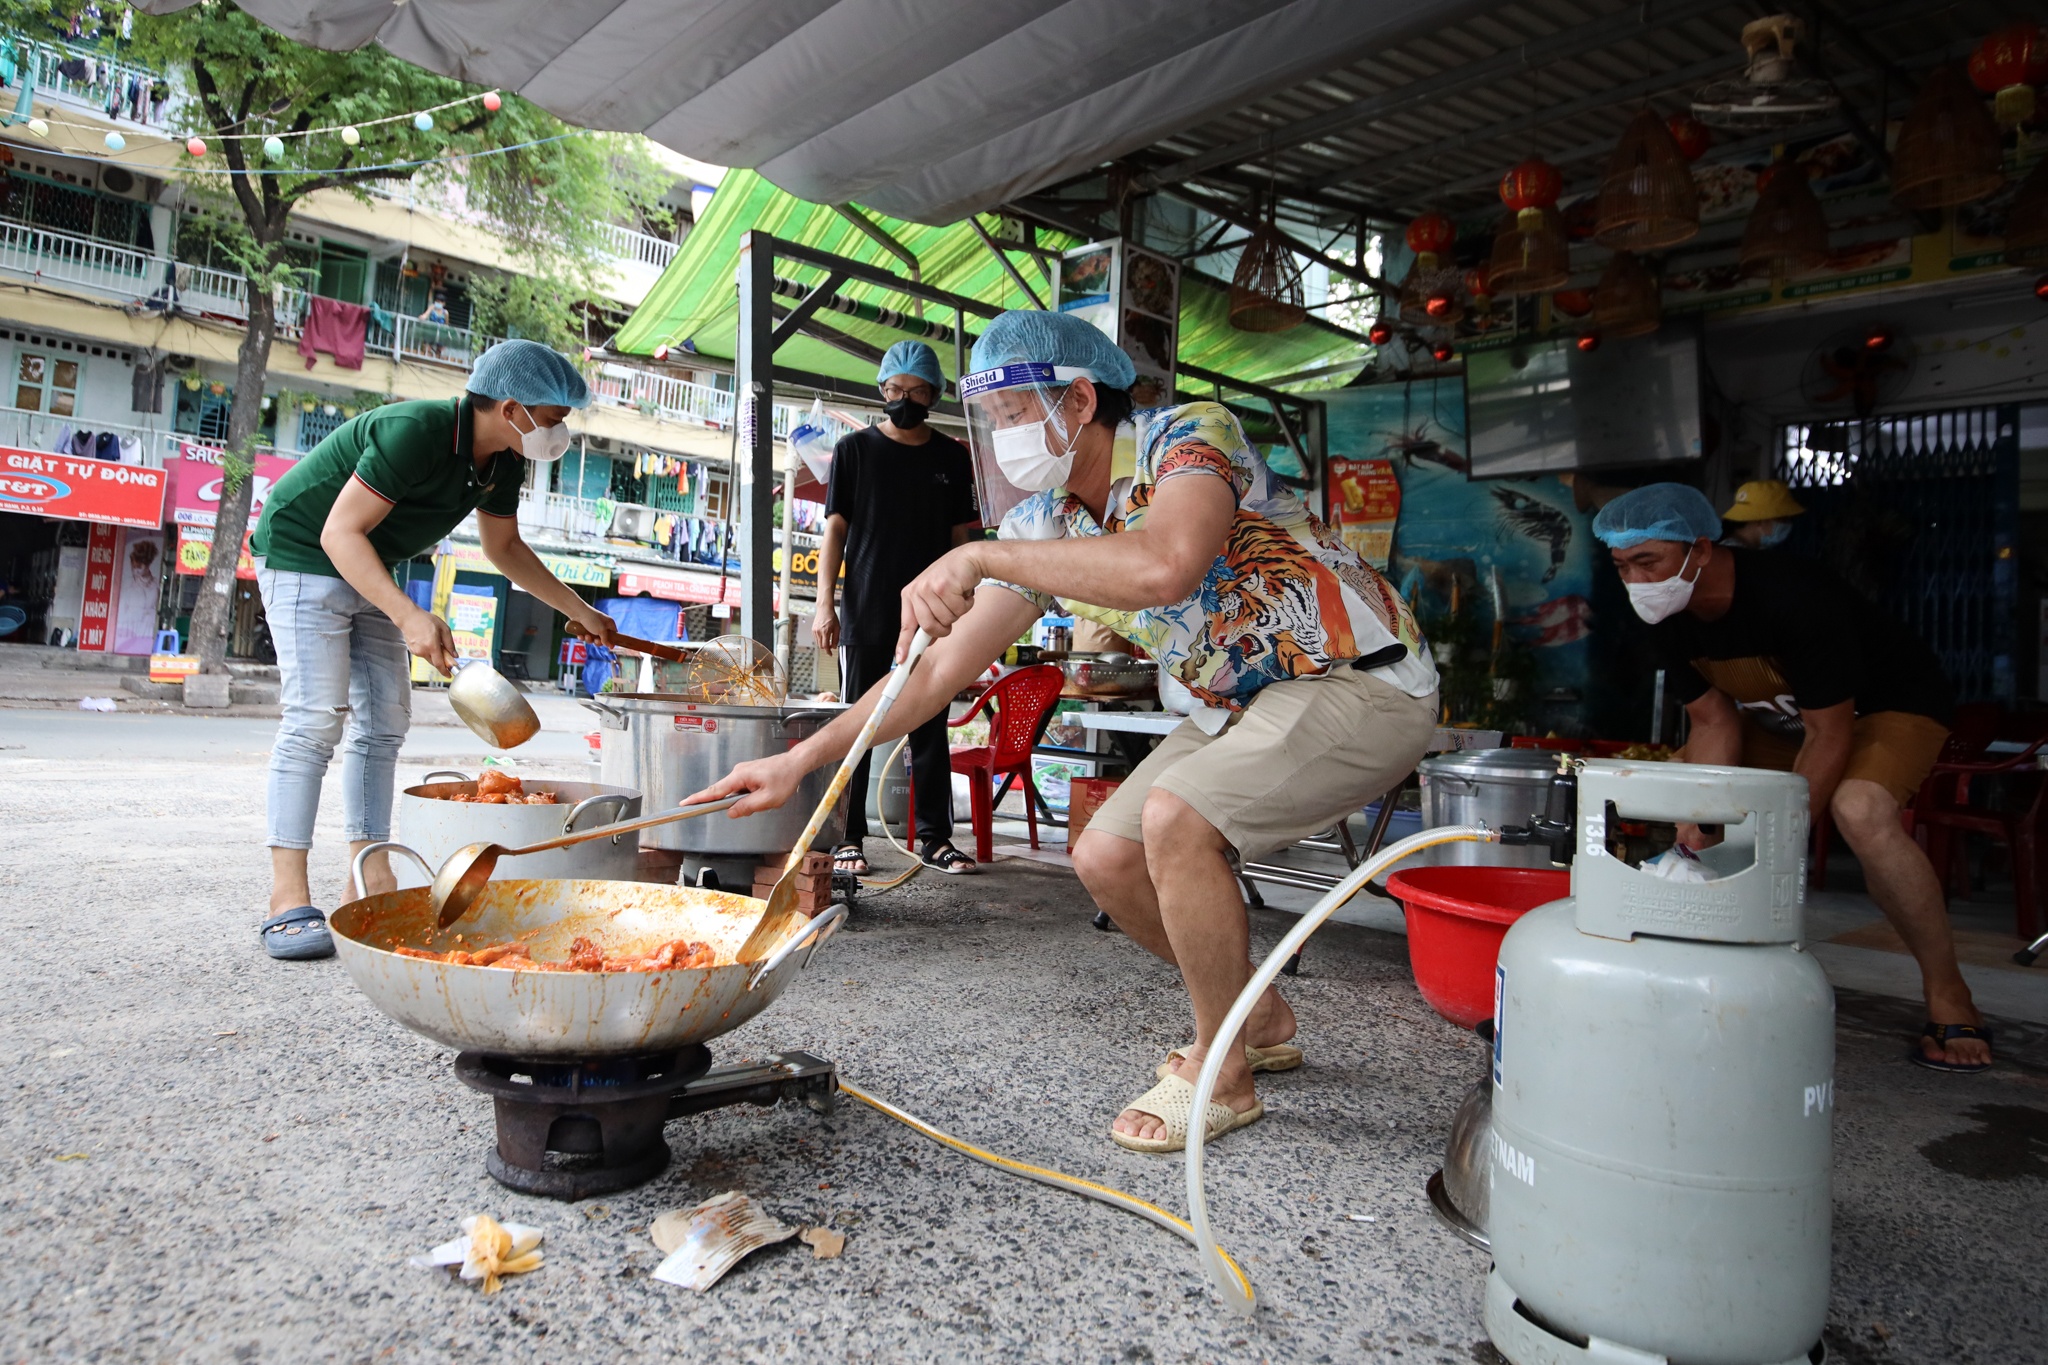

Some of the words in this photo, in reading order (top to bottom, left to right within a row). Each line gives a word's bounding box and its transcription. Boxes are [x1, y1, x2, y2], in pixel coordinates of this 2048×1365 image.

[965, 370, 997, 389] Shield
[7, 454, 59, 474] GIẶT
[65, 462, 97, 480] TỰ
[100, 467, 158, 488] ĐỘNG
[652, 579, 673, 590] PEACH
[673, 581, 685, 591] TEA
[84, 598, 108, 619] KHÁCH
[891, 786, 910, 795] PETR
[1585, 813, 1606, 857] 13.6
[1804, 1082, 1827, 1117] PV
